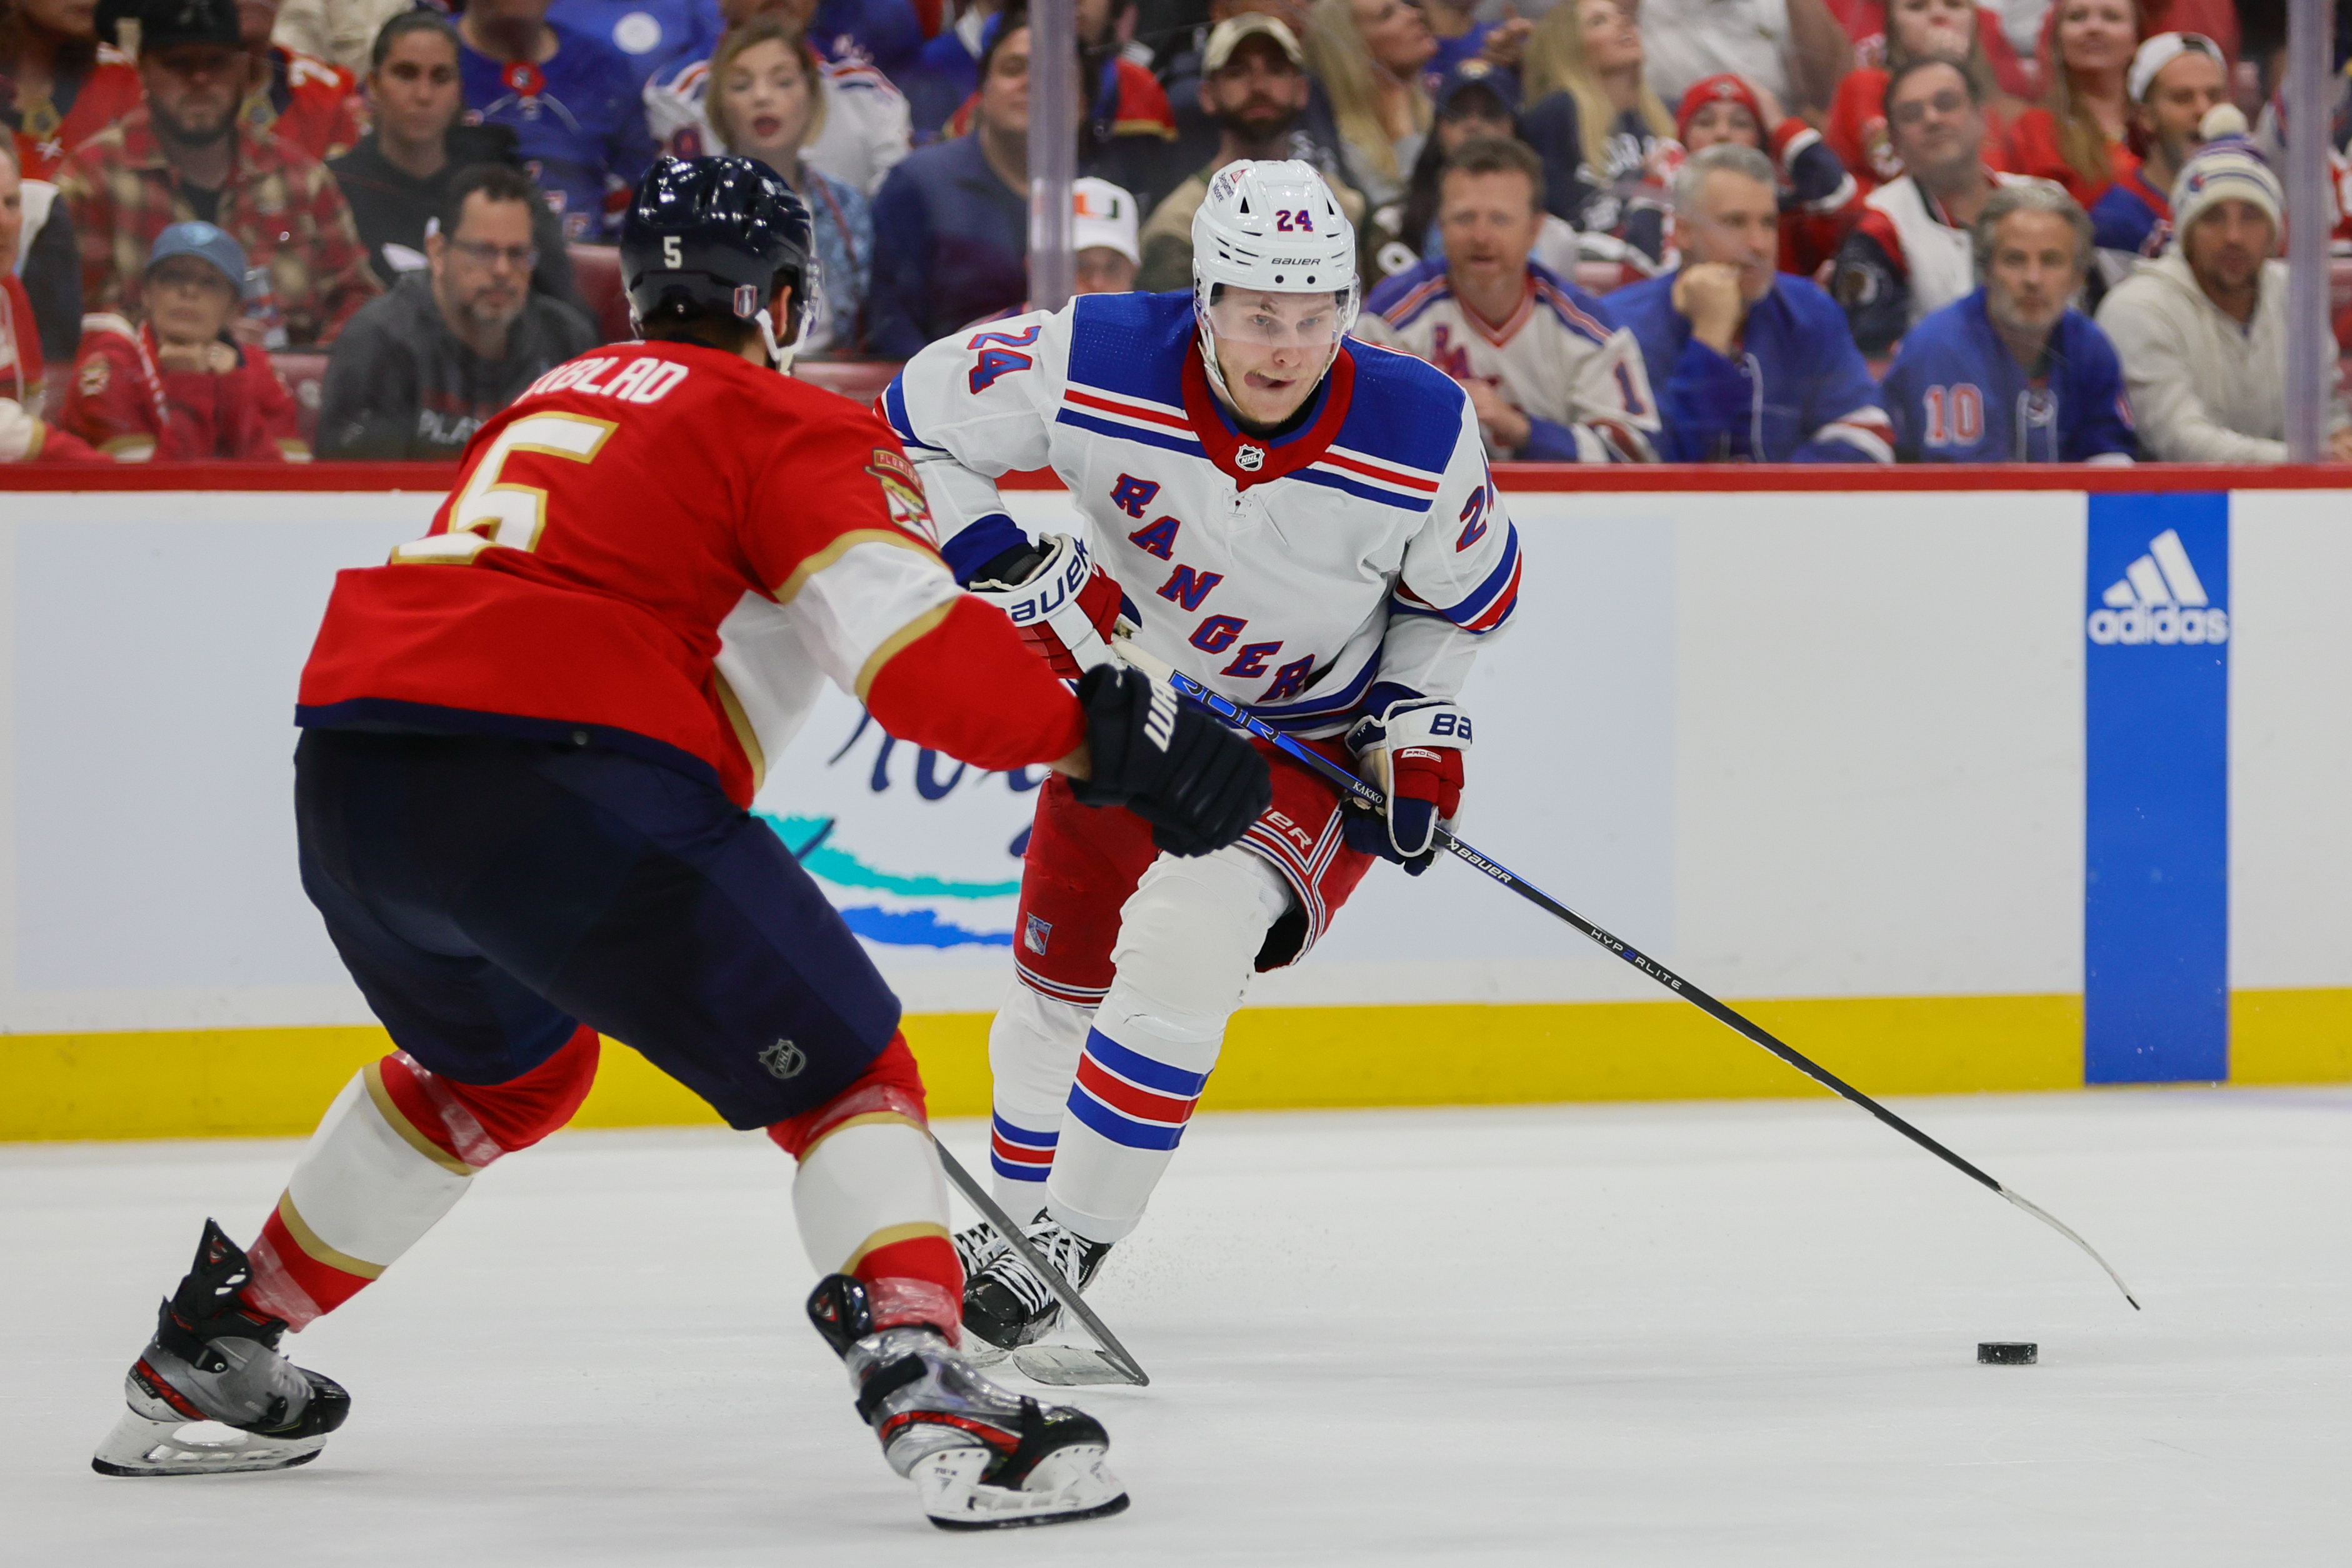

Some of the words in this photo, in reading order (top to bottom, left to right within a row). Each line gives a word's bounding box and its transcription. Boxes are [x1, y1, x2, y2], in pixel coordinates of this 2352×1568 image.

[1212, 182, 1224, 202] Moore
[1219, 172, 1234, 197] Benjamin
[1275, 209, 1314, 232] 24
[663, 236, 682, 269] 5
[1271, 257, 1321, 266] BAUER
[966, 325, 1043, 396] 24
[511, 357, 689, 404] BLAD
[1923, 382, 1985, 448] 10
[389, 410, 619, 566] 5
[1000, 536, 1089, 623] AUER
[1109, 472, 1316, 705] RANGER
[2088, 605, 2229, 646] adidas
[1353, 781, 1384, 804] KAKKO
[1457, 847, 1513, 883] BAUER
